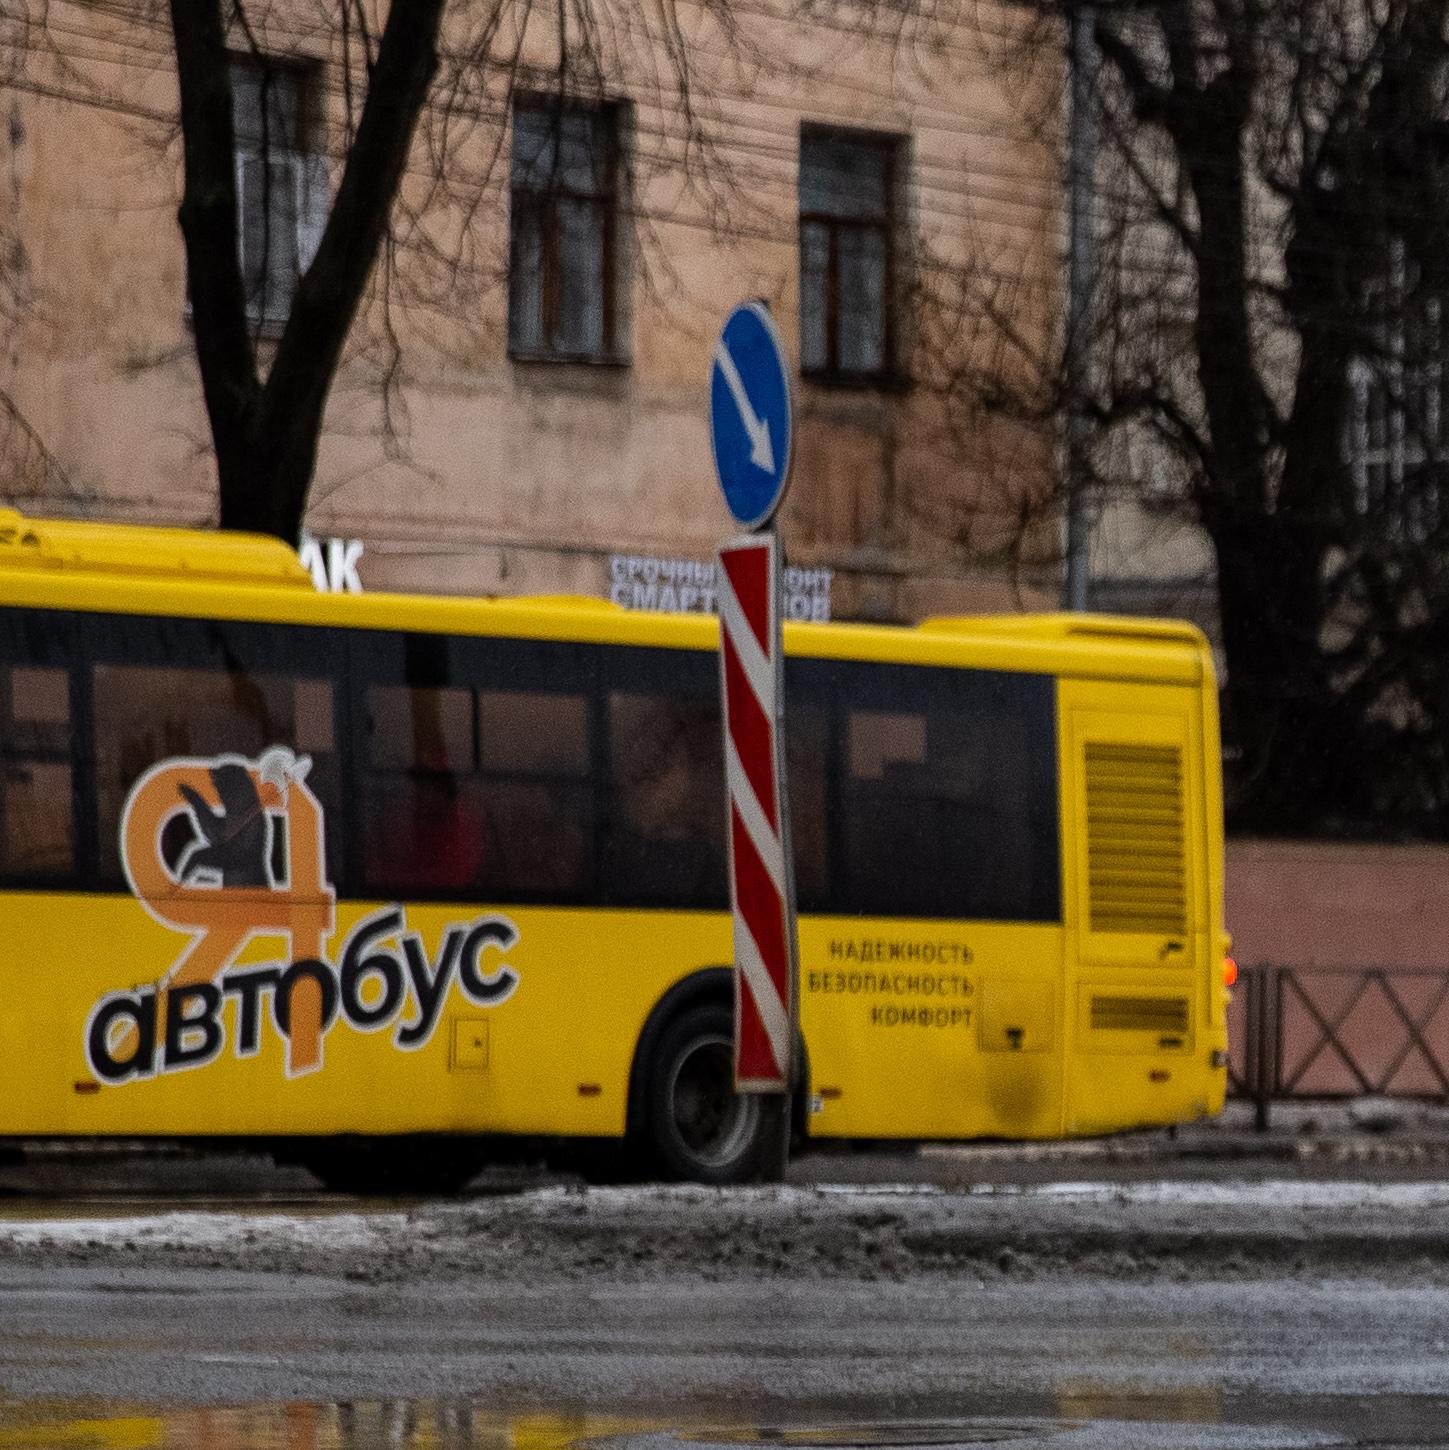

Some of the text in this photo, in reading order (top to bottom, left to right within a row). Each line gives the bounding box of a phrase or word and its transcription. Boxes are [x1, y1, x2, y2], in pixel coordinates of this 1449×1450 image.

[610, 556, 718, 586] СРОЧНЫ
[829, 939, 975, 965] НАДЕЖНОСТЬ
[88, 908, 519, 1082] автобус
[807, 971, 975, 997] БЕЗОПАСНОСТЬ
[871, 1004, 972, 1028] КОМФОРТ
